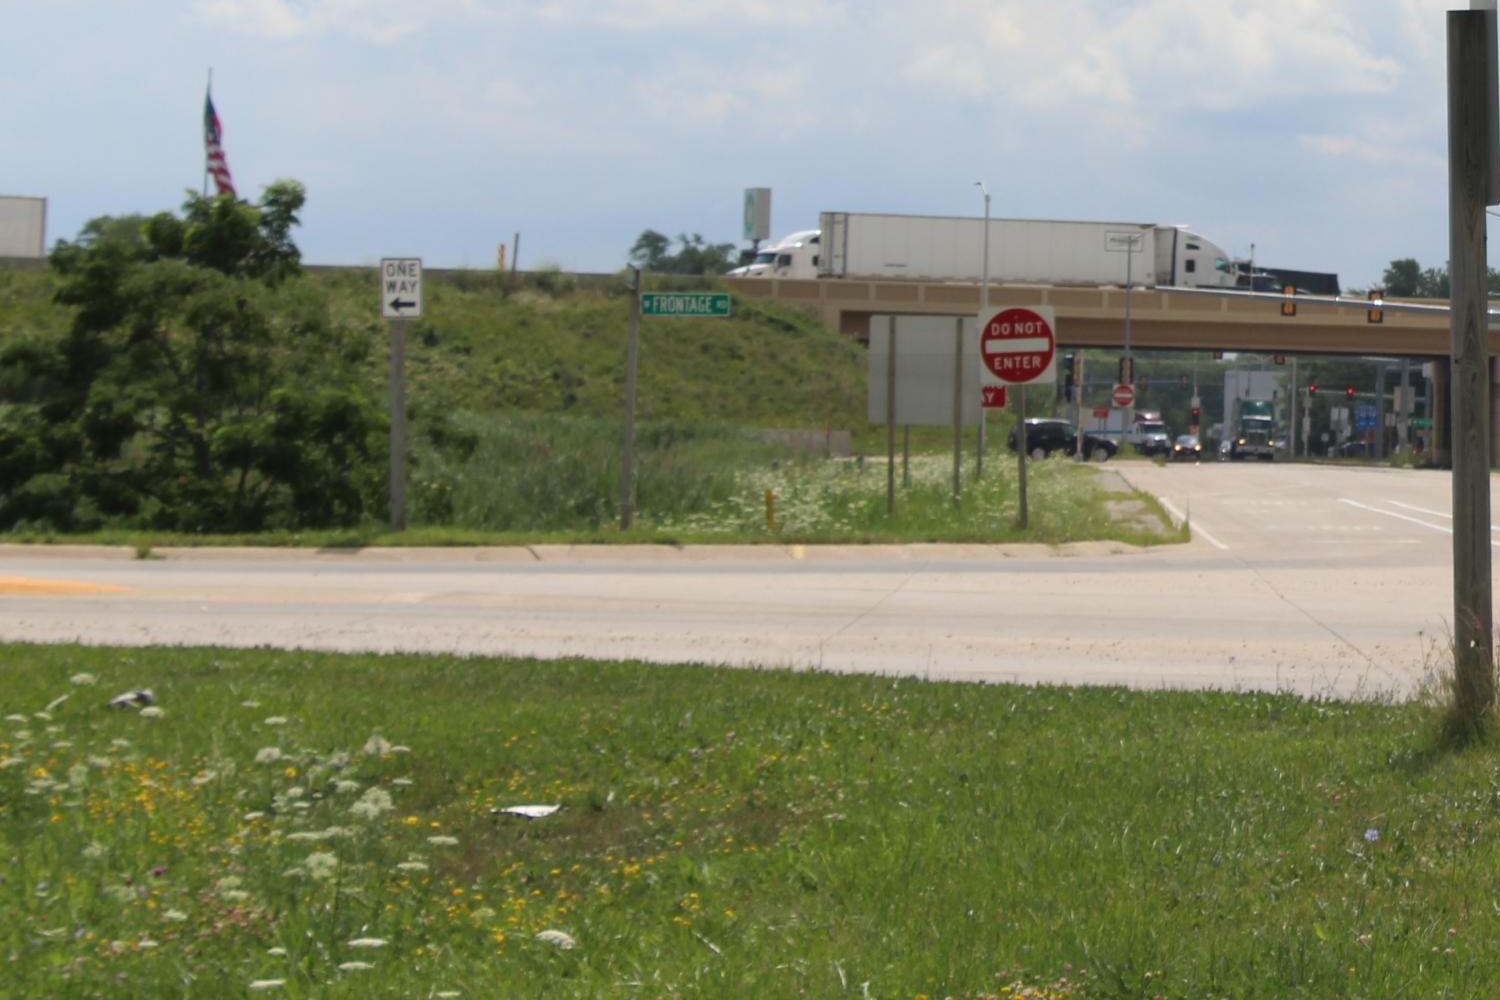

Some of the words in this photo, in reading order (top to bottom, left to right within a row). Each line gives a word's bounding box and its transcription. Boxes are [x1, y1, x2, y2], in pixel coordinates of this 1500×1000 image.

[386, 263, 417, 277] ONE
[386, 280, 418, 294] WAY
[653, 296, 713, 312] FRONTAGE
[991, 323, 1010, 336] DO
[1014, 321, 1043, 335] NOT
[994, 356, 1041, 370] ENTER
